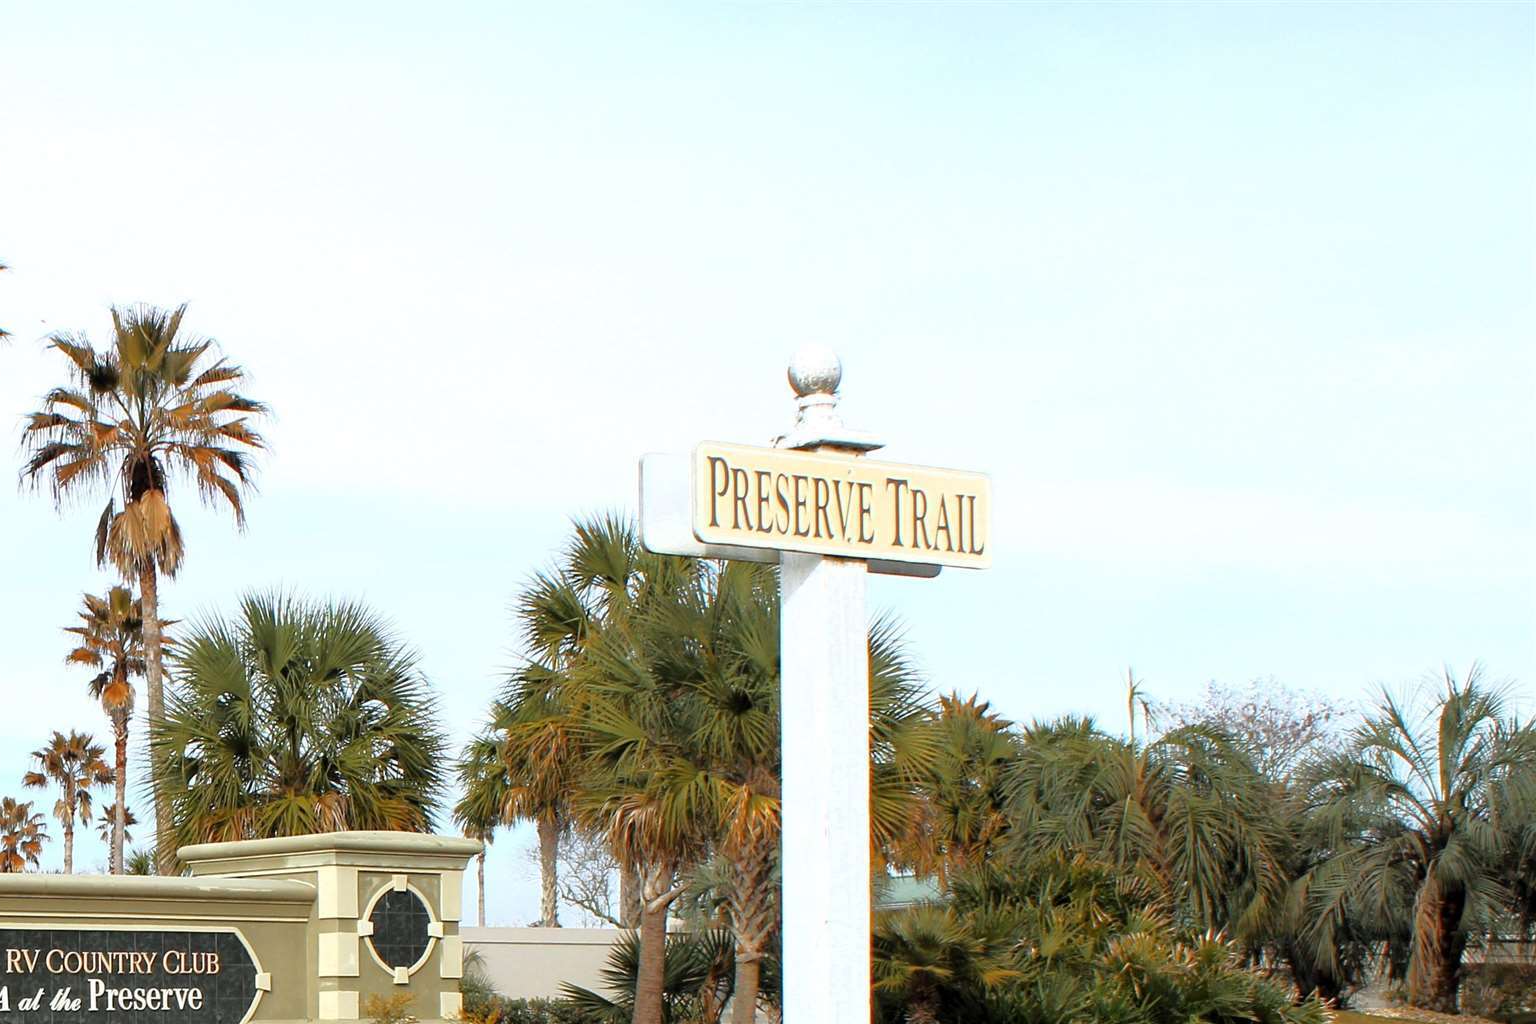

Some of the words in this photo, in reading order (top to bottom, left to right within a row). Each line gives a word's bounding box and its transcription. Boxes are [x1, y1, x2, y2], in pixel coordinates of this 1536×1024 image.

[707, 456, 874, 545] PRESERVE
[886, 477, 985, 556] TRAIL
[5, 948, 41, 974] RV
[45, 949, 158, 974] COUNTRY
[162, 950, 221, 974] CLUB
[18, 988, 44, 1011] at
[49, 987, 81, 1011] the
[88, 979, 203, 1010] Preserve
